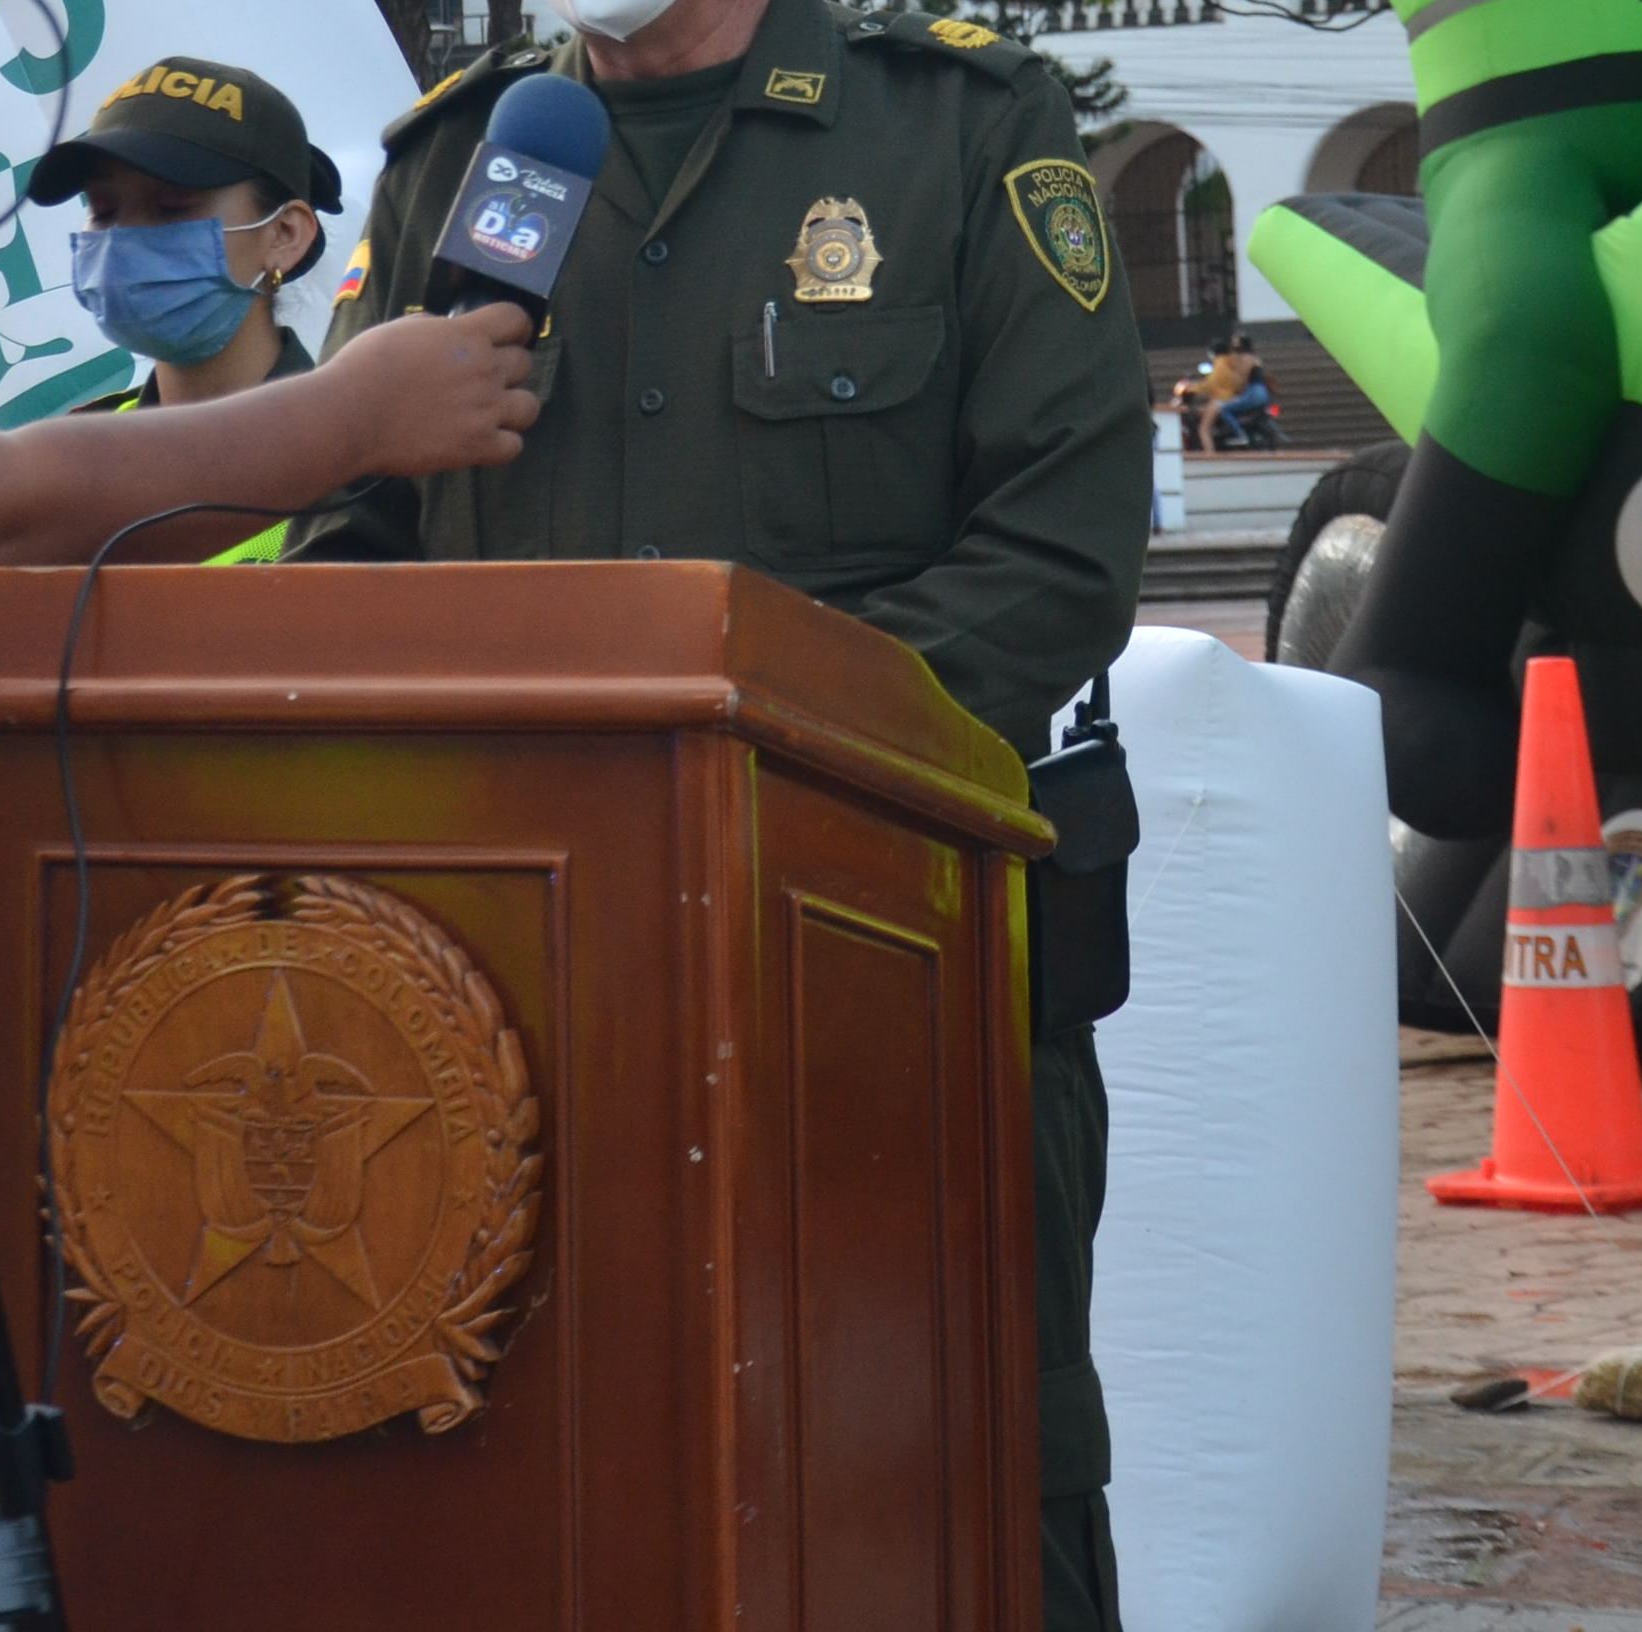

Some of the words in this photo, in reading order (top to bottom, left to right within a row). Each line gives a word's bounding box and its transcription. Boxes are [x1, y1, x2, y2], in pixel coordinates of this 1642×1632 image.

[102, 65, 243, 122] LICIA
[258, 933, 298, 957] DE
[339, 944, 481, 1142] COLOMBIA
[111, 1261, 231, 1374] POLICIA
[306, 1270, 457, 1382] NACIONAL
